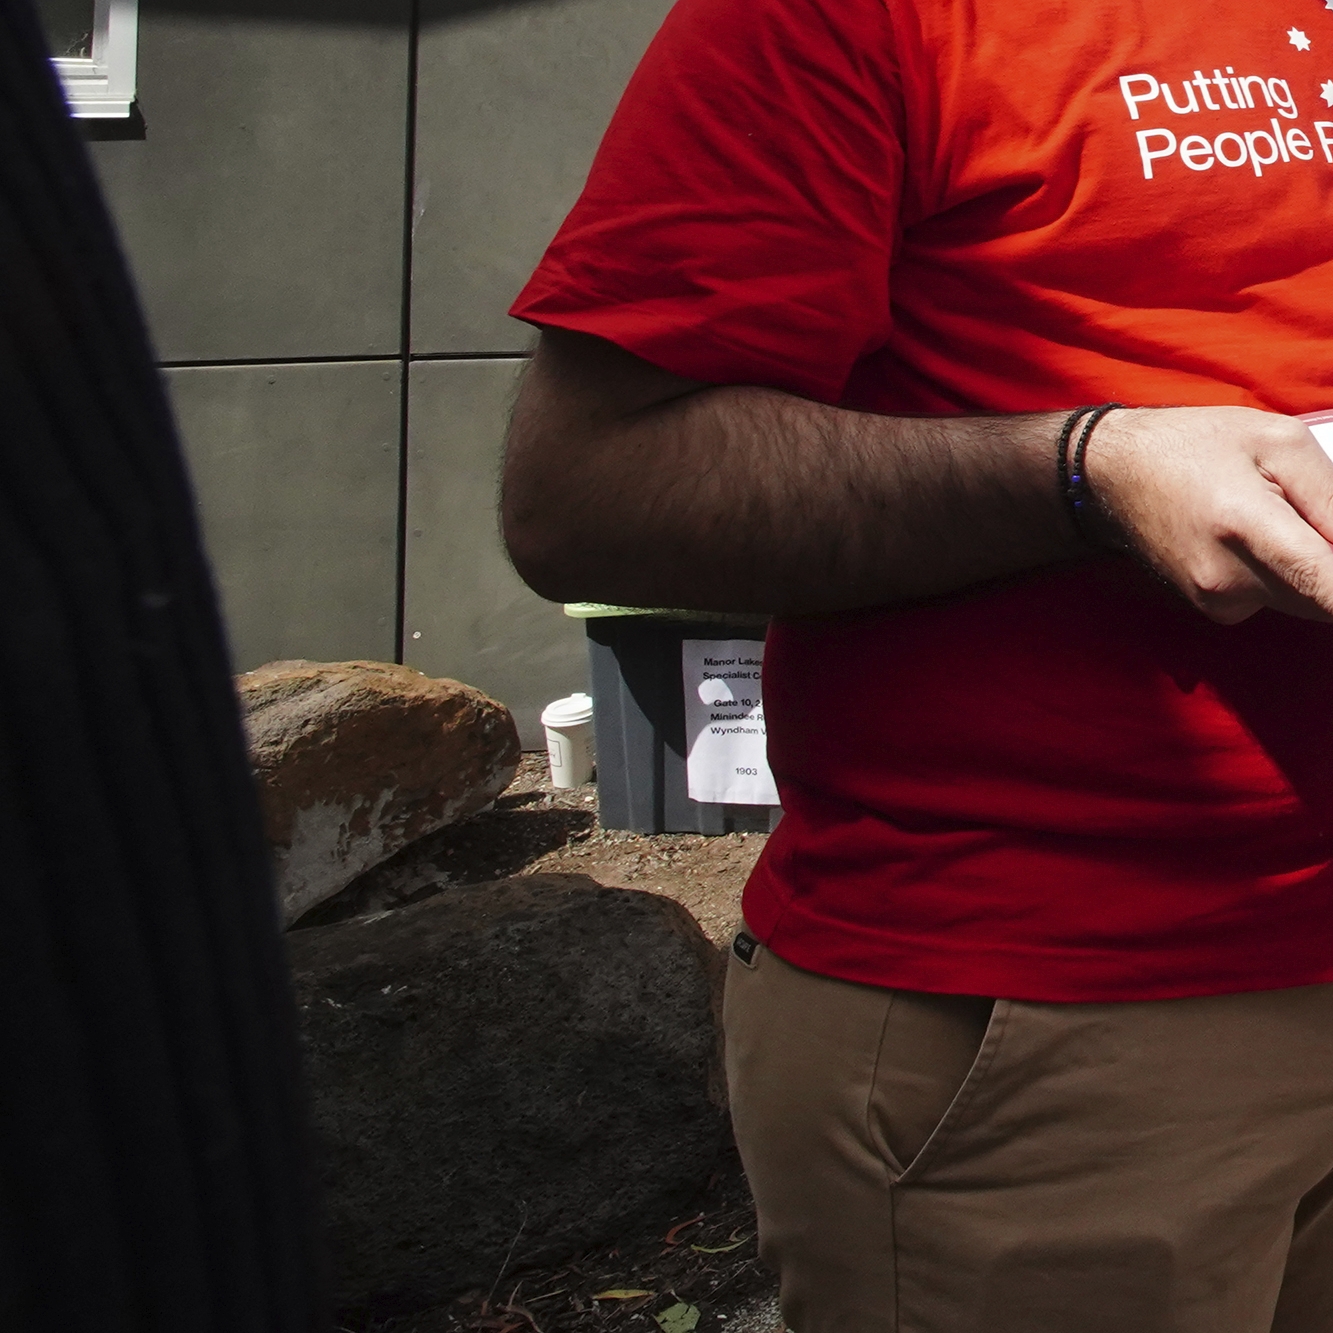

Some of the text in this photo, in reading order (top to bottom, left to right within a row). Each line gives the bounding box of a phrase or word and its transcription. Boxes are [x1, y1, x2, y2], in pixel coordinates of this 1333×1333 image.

[1119, 66, 1298, 120] Putting
[1135, 118, 1314, 180] People
[703, 657, 735, 667] Manor
[702, 671, 751, 681] Specialist
[713, 699, 738, 707] Gate
[741, 699, 753, 708] 10,
[710, 726, 759, 735] Wyndham
[735, 767, 758, 776] 1903
